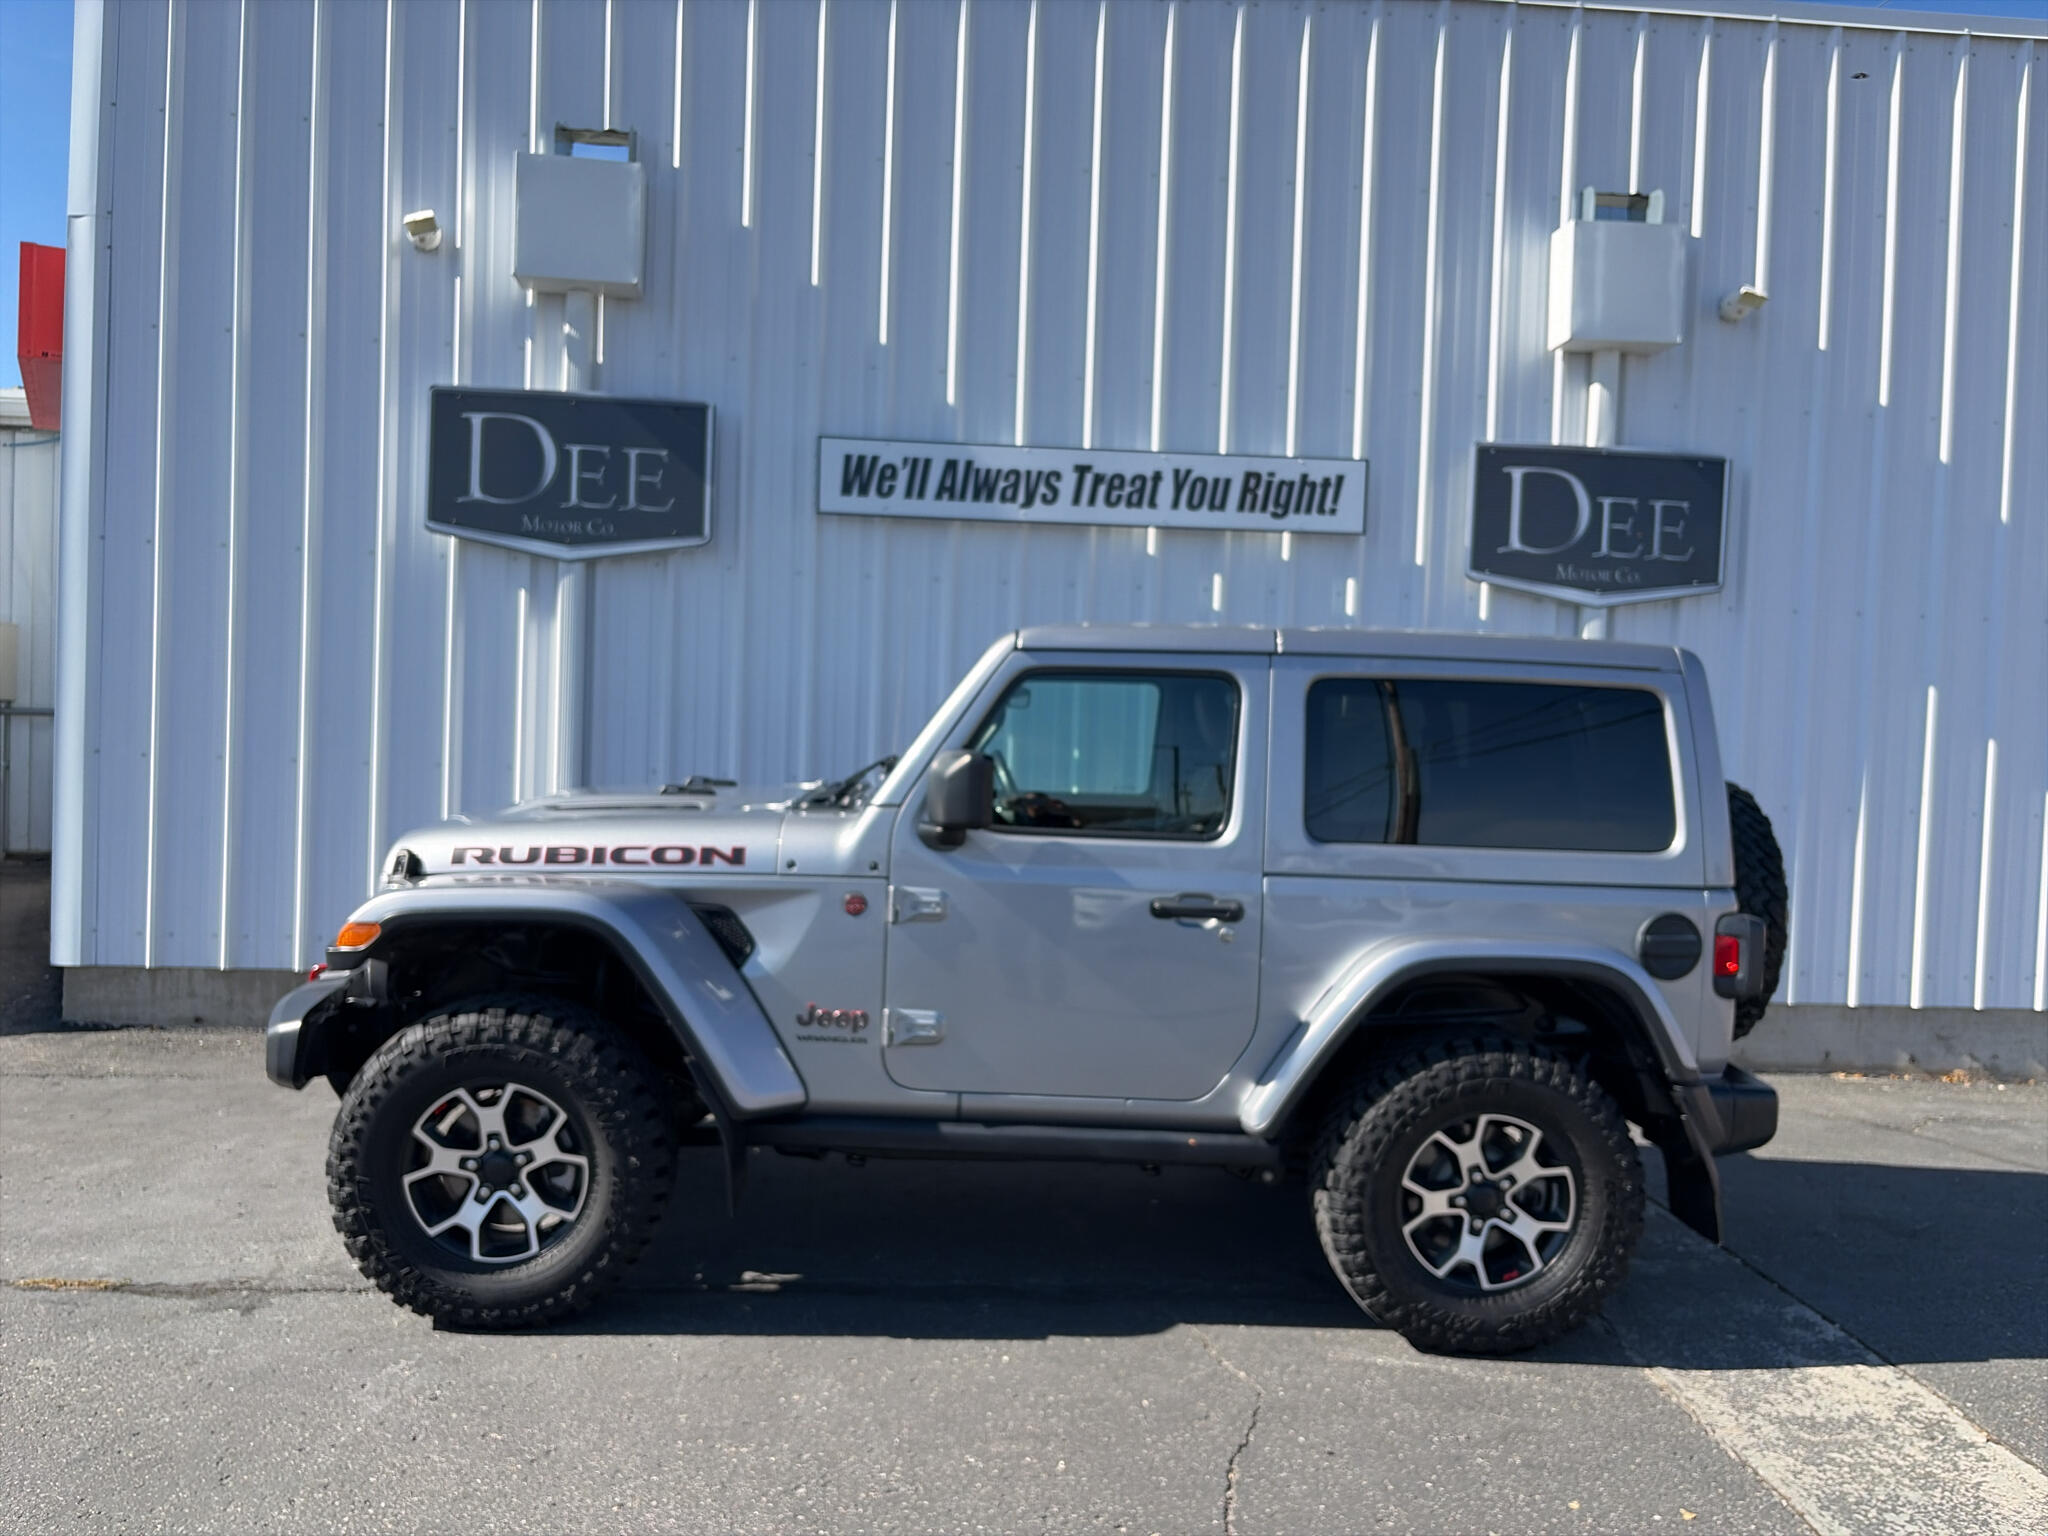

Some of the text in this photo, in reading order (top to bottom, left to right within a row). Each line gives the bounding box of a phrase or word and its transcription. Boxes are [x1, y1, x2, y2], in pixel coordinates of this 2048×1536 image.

[456, 410, 675, 512] DEE
[840, 453, 1345, 519] We'll Always Treat You Right!
[1497, 465, 1695, 562] DEE
[450, 846, 747, 866] RUBICON
[796, 1002, 869, 1033] Jeep
